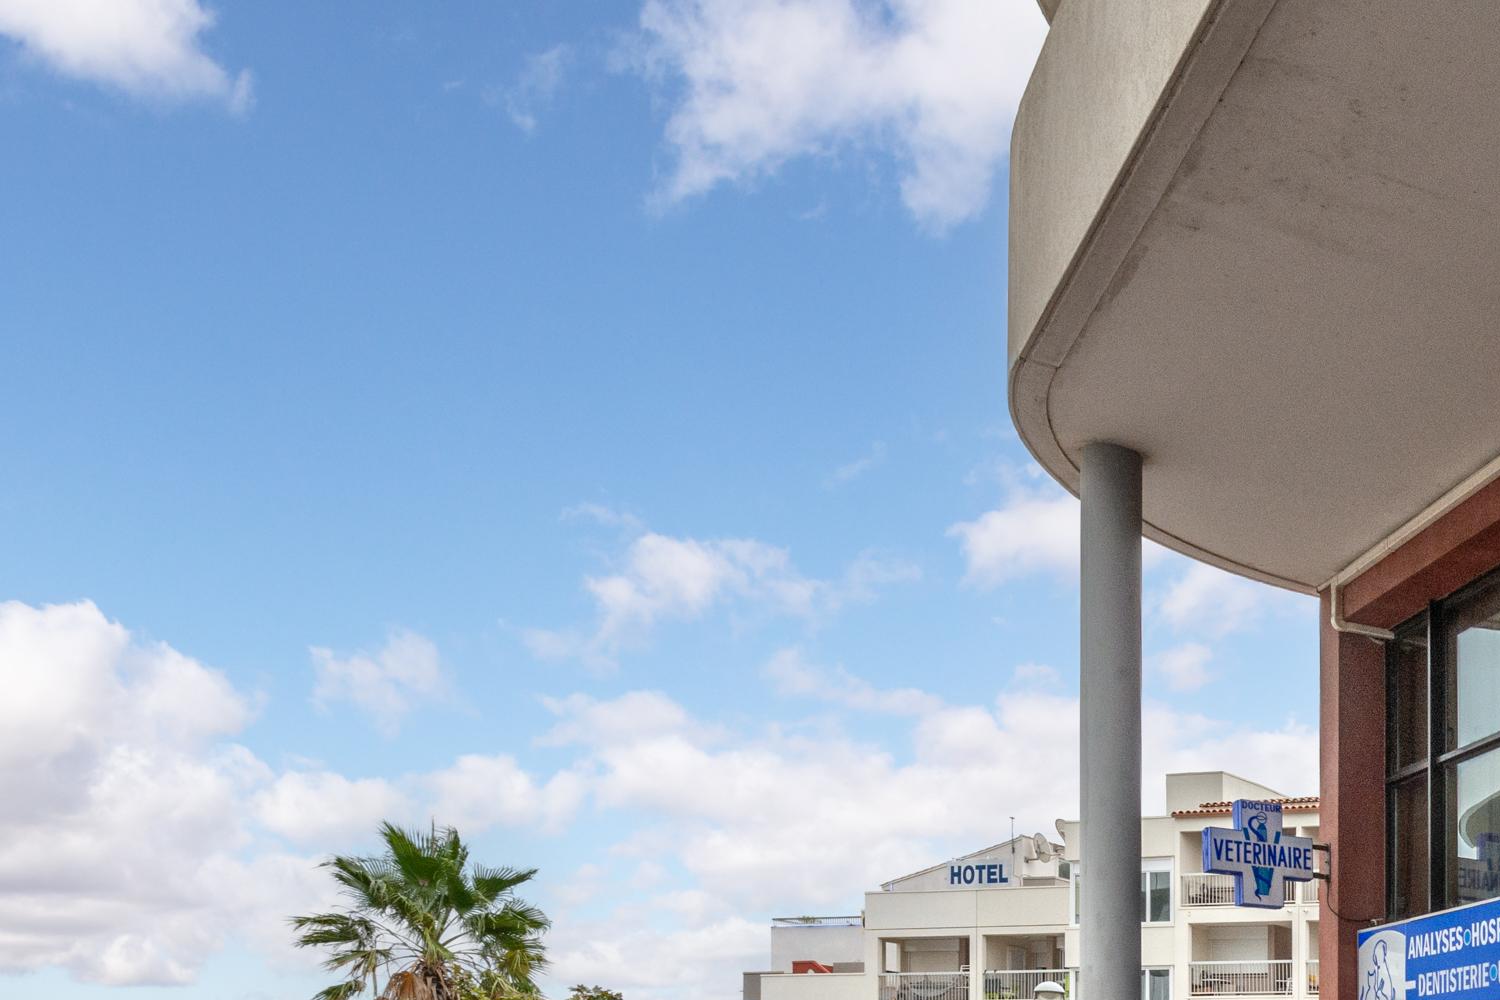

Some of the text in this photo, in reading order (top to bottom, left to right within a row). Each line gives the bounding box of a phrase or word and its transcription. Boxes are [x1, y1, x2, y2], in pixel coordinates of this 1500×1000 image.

[1242, 801, 1282, 813] DOCTEUR
[1213, 838, 1312, 870] VETERINAIRE
[950, 864, 1008, 884] HOTEL
[1408, 926, 1463, 959] ANALYSES
[1418, 962, 1490, 997] DENTISTERIE
